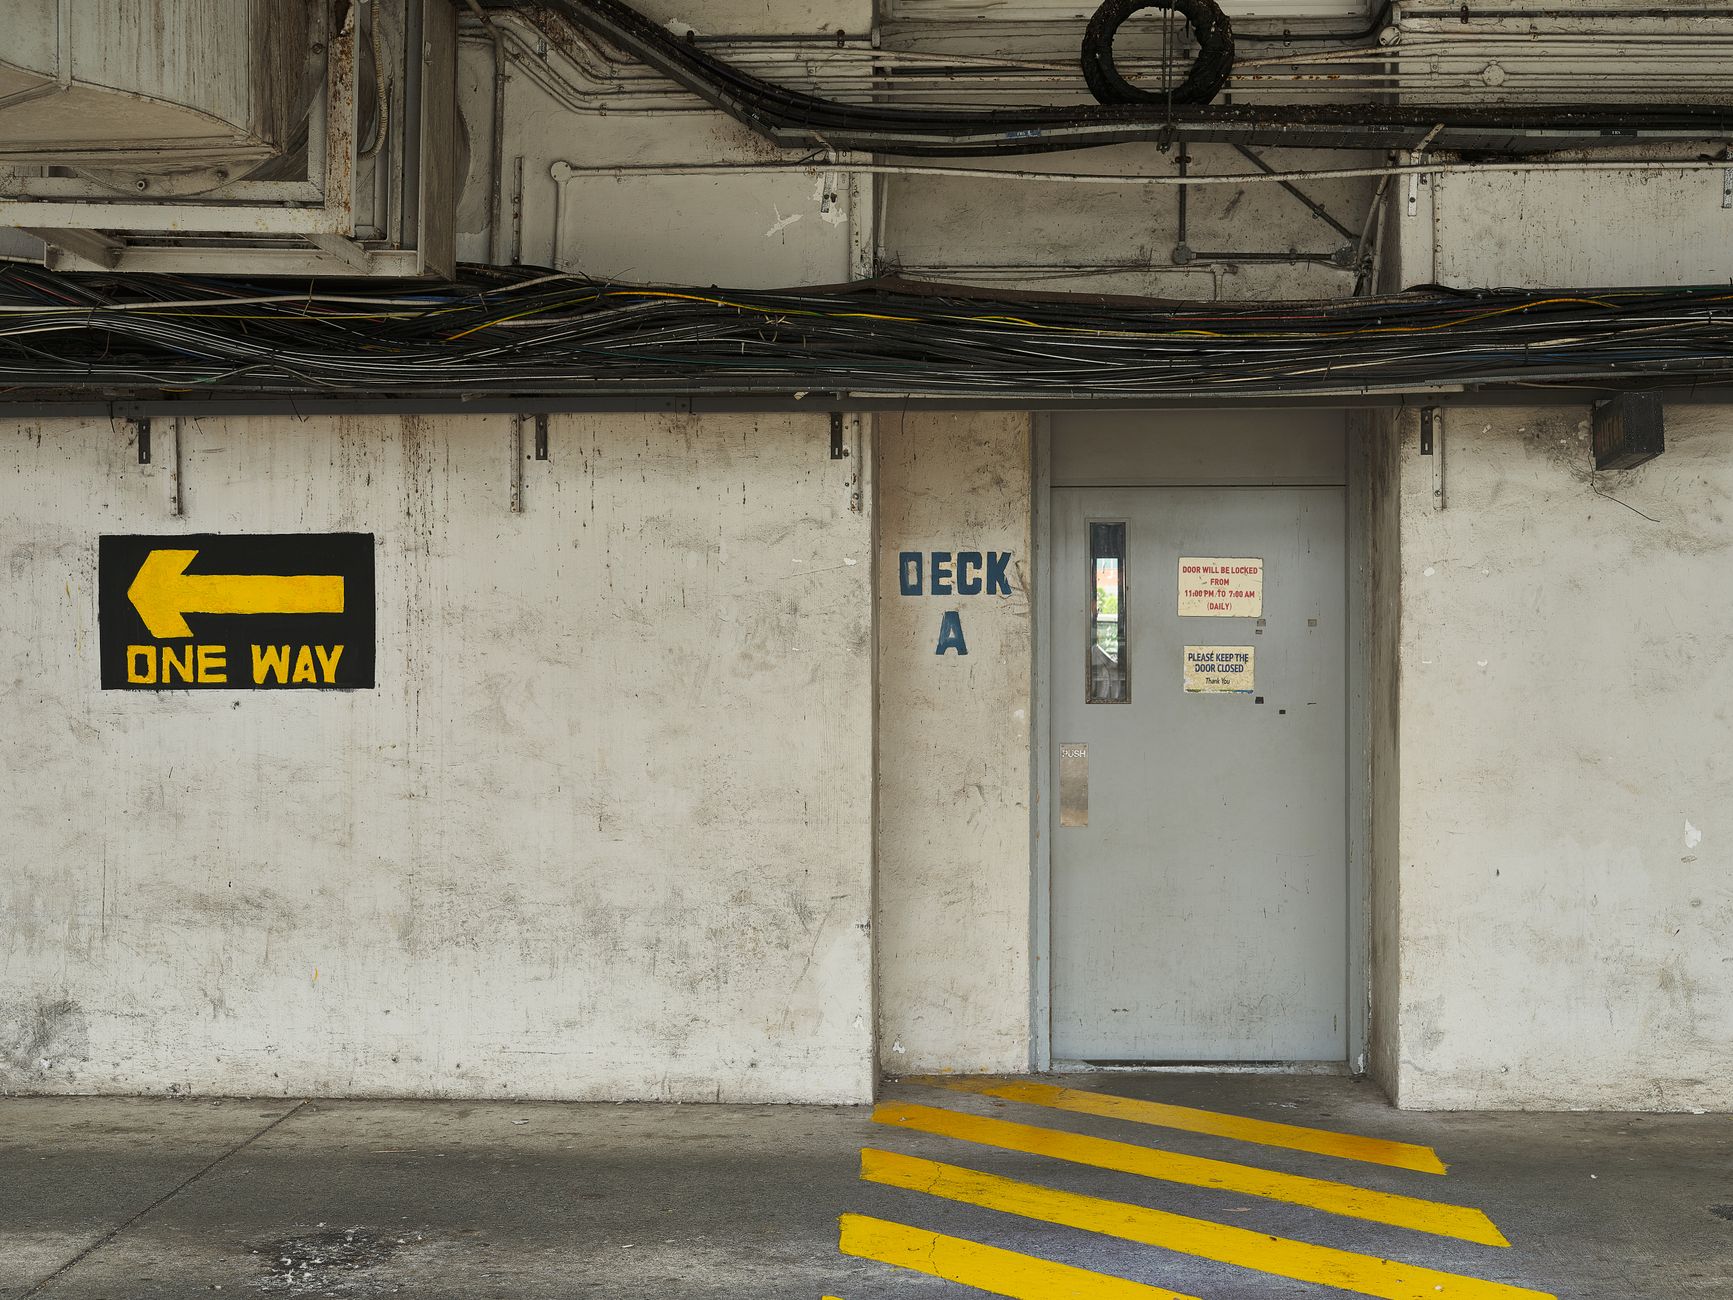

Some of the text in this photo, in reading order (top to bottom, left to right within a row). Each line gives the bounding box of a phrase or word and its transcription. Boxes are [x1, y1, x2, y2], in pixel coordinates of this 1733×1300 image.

[899, 551, 1012, 596] DECK
[1207, 602, 1232, 611] (DAILY)
[935, 611, 968, 655] A
[1188, 653, 1249, 663] PLEASE KEEP THE
[127, 644, 345, 685] ONE WAY
[1195, 664, 1244, 672] DOOR CLOSED
[1062, 749, 1086, 758] PUSH
